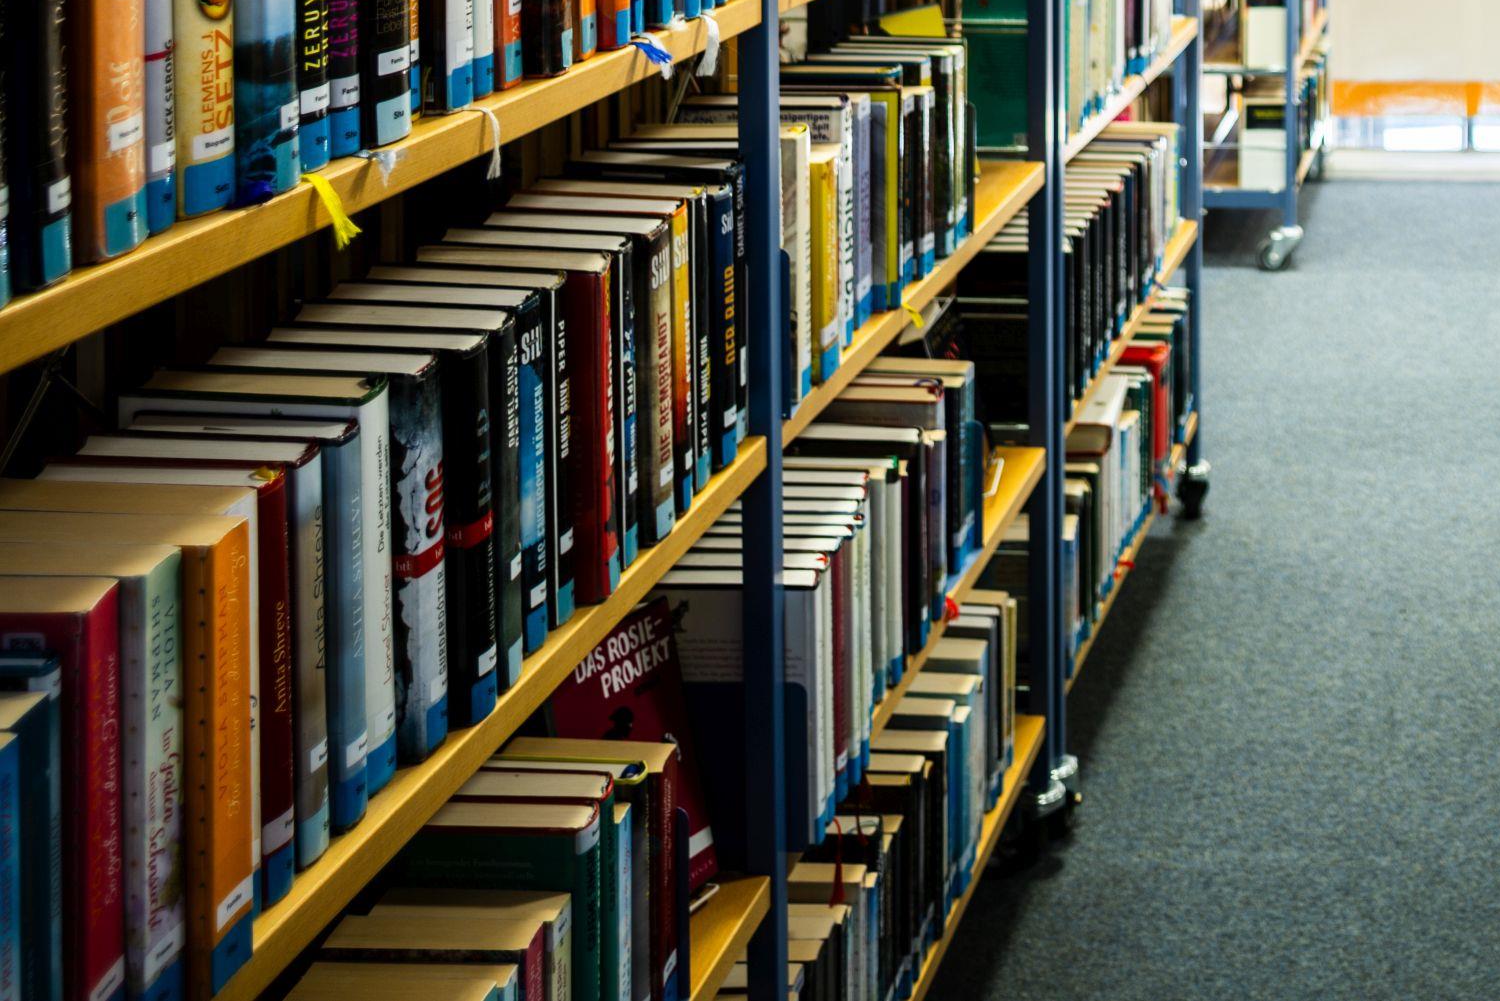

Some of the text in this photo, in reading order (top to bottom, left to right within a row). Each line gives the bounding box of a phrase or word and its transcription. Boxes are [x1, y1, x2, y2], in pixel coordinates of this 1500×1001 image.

[201, 31, 215, 134] CLEMENS J.
[215, 23, 233, 131] SETZ
[559, 379, 569, 458] DANIEL SILVA
[656, 311, 671, 463] DIE REMBRANDT
[424, 460, 444, 538] SOG
[313, 504, 327, 670] Anita Shreve
[352, 488, 363, 659] ANITA SHREVE
[150, 593, 162, 720] SHIPMAN
[163, 603, 174, 689] VIOLA
[273, 601, 287, 713] Anita Shreve
[382, 573, 392, 685] Lionel Shriver
[575, 646, 606, 684] DAS
[606, 616, 662, 662] ROSIE-
[600, 636, 670, 699] PROJEKT
[218, 584, 228, 799] VIOLA SHIPMAN
